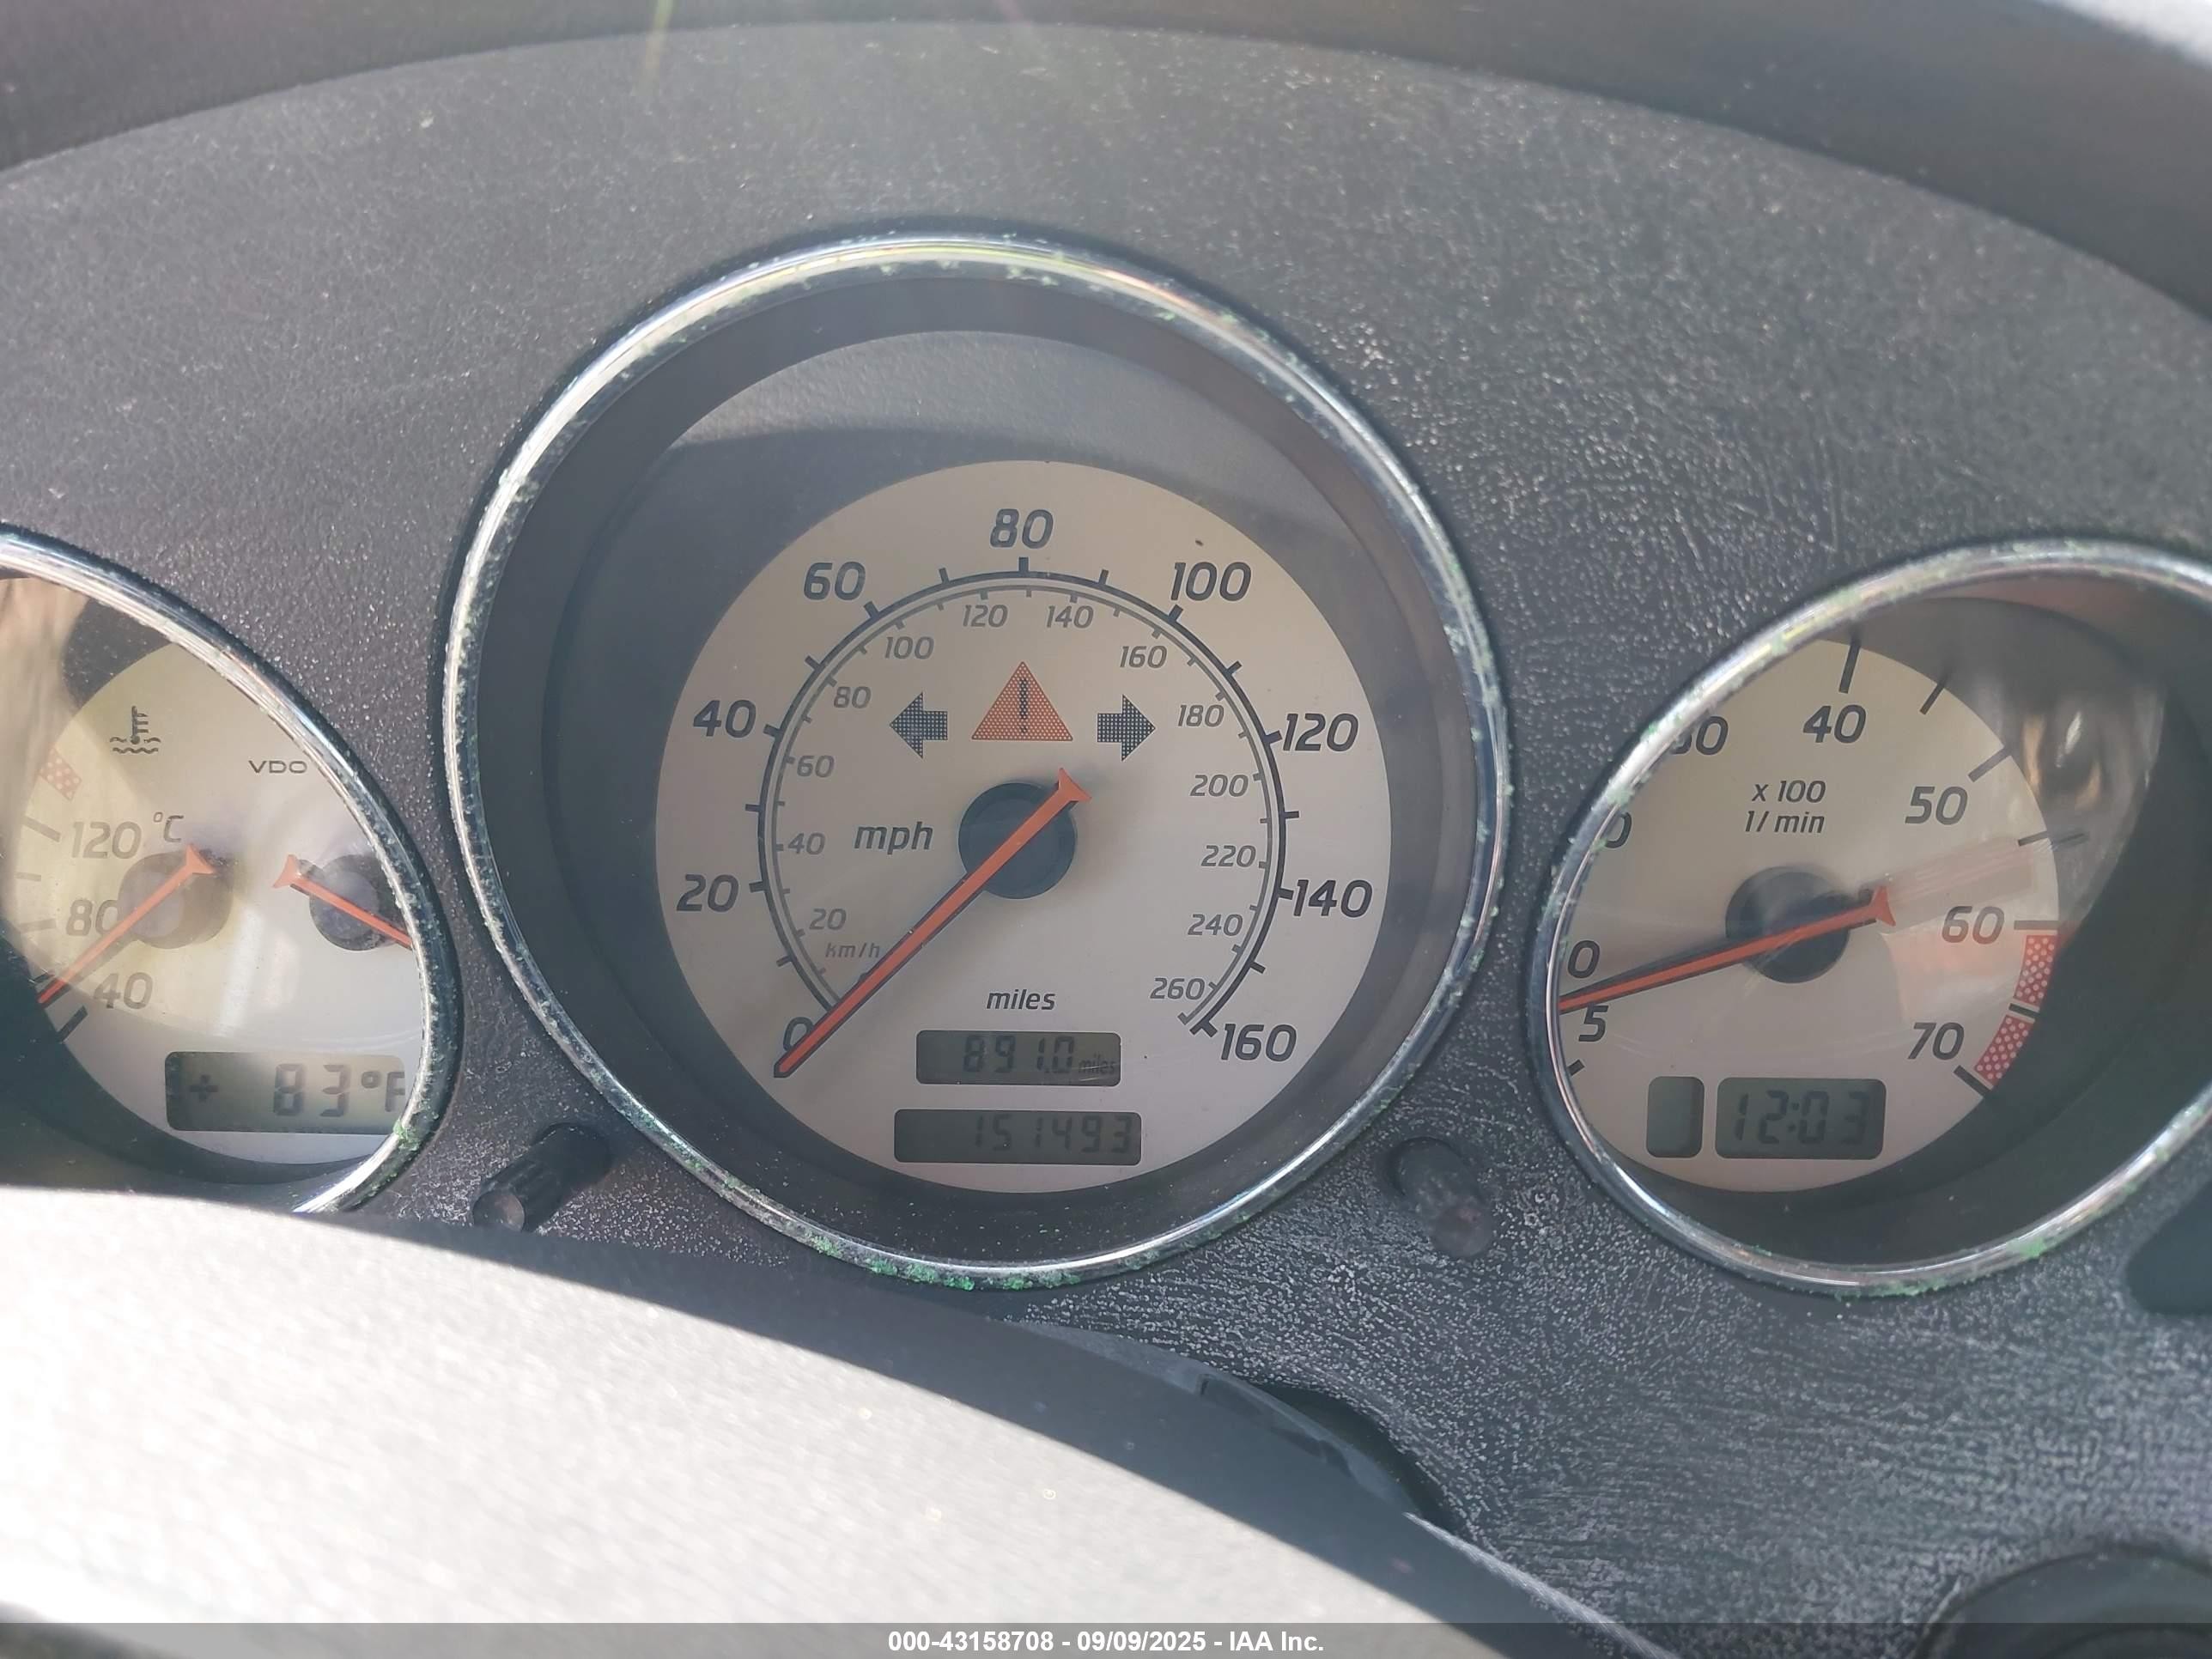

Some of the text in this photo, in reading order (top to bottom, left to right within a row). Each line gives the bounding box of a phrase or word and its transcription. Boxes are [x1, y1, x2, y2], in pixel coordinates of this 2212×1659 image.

[990, 508, 1054, 548] 80
[803, 561, 866, 600] 60
[1170, 562, 1251, 601] 100
[963, 605, 1008, 628] 120
[1047, 605, 1094, 629] 140
[884, 636, 934, 659] 100
[1119, 646, 1167, 668] 160
[833, 686, 872, 708] 80
[693, 700, 756, 738] 40
[1177, 704, 1224, 727] 180
[1802, 705, 1867, 744] 40
[1283, 713, 1358, 752] 120
[248, 760, 307, 774] VDO
[796, 755, 835, 778] 60
[1190, 775, 1249, 797] 200
[1778, 780, 1826, 803] 100
[1904, 785, 1968, 825] 50
[71, 821, 142, 860] 120
[787, 832, 825, 855] 40
[854, 822, 933, 854] mph
[1200, 845, 1256, 867] 220
[676, 874, 739, 912] 20
[1292, 880, 1372, 918] 140
[809, 908, 847, 930] 20
[1188, 914, 1243, 936] 240
[1941, 906, 2005, 945] 60
[825, 942, 879, 957] km/h
[93, 971, 154, 1010] 40
[987, 988, 1055, 1011] miles
[1150, 978, 1205, 1000] 260
[1578, 1003, 1608, 1042] 5
[1220, 1024, 1297, 1061] 160
[1906, 1022, 1965, 1060] 70
[975, 1114, 1133, 1153] 151493
[1735, 1090, 1870, 1145] 12:03
